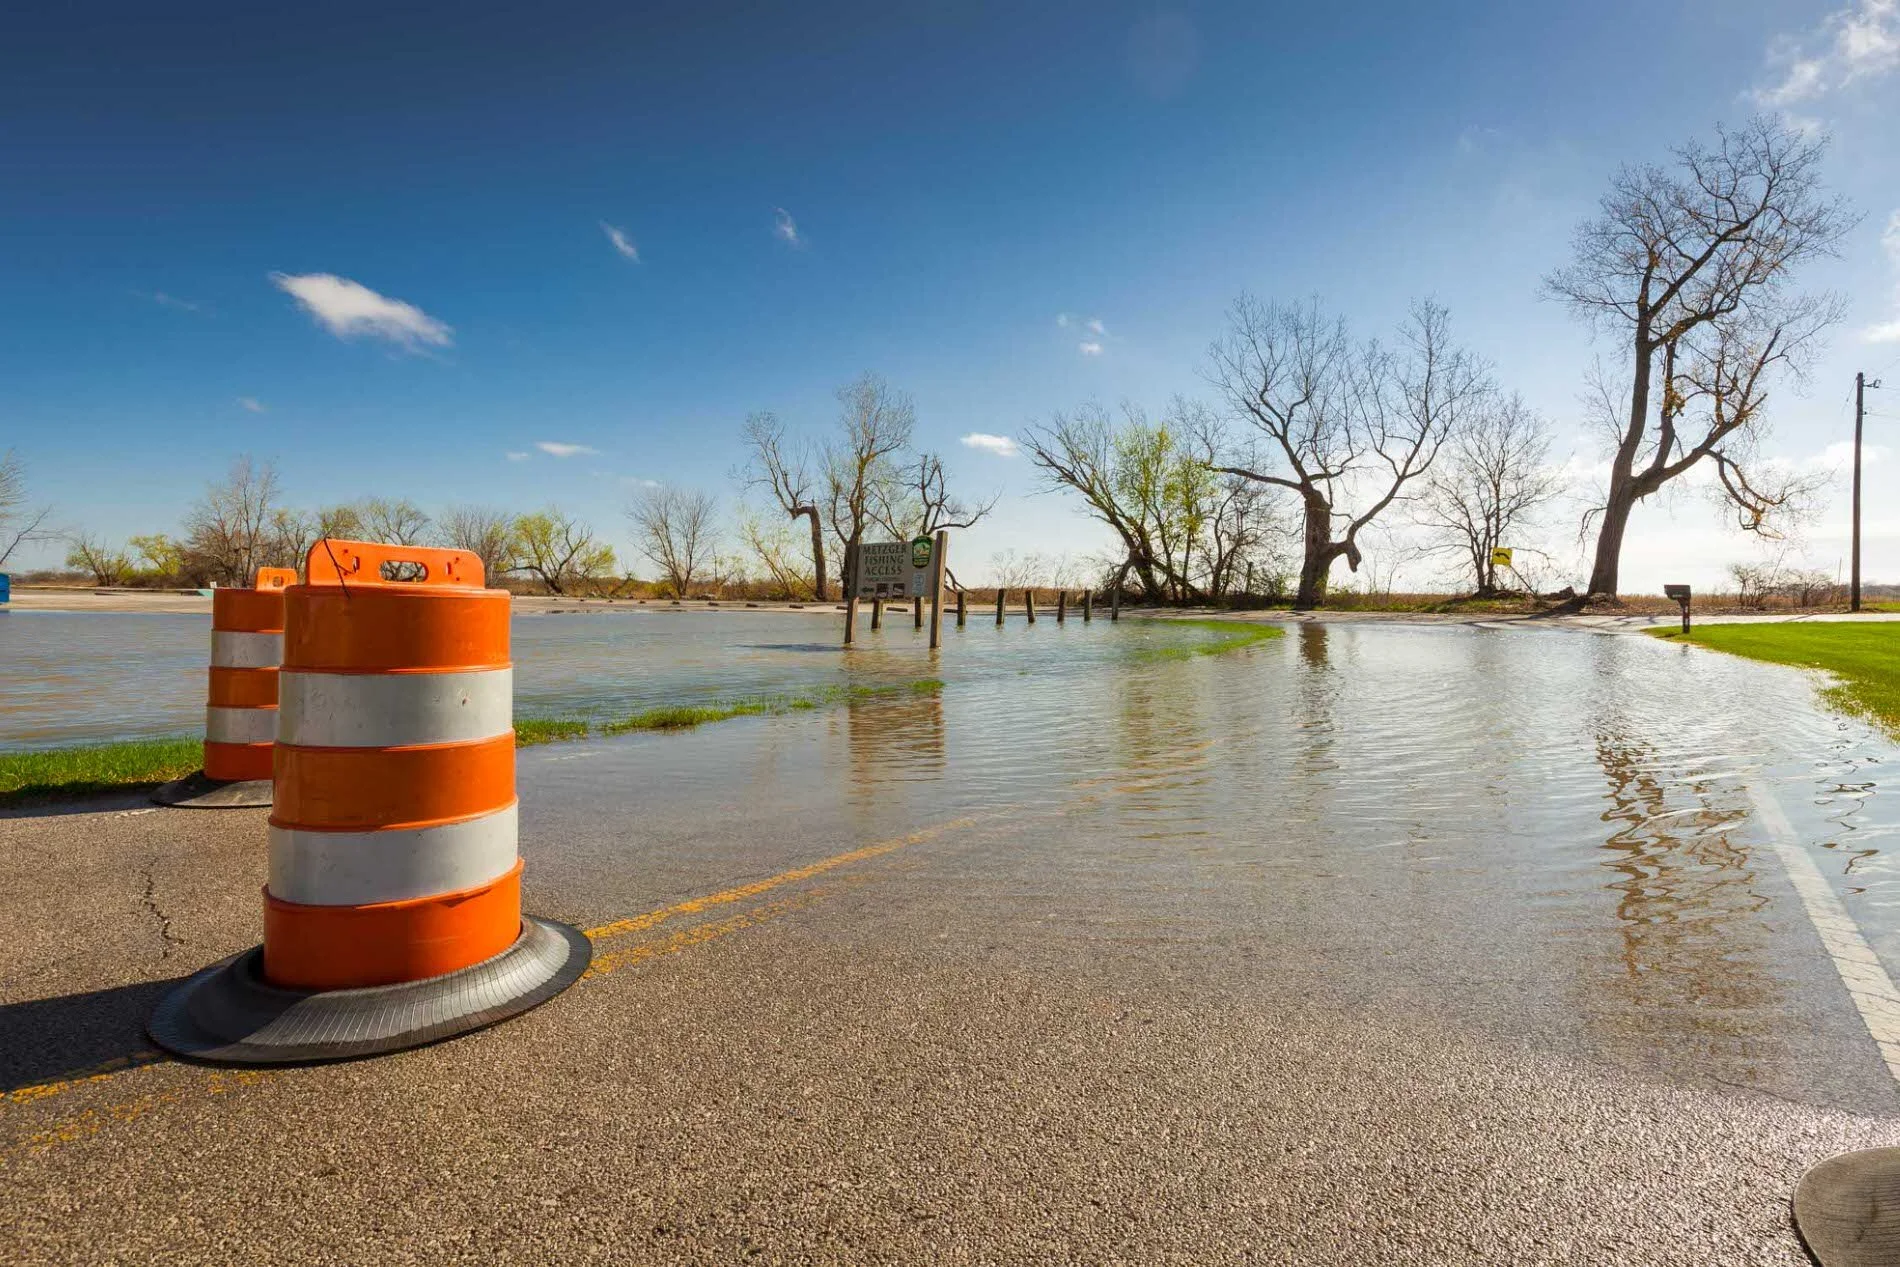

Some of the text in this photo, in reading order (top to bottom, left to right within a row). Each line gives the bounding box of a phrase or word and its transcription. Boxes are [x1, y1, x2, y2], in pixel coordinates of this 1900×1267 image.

[863, 543, 907, 554] METZGER
[865, 555, 904, 565] FISHING
[865, 566, 903, 576] ACCESS
